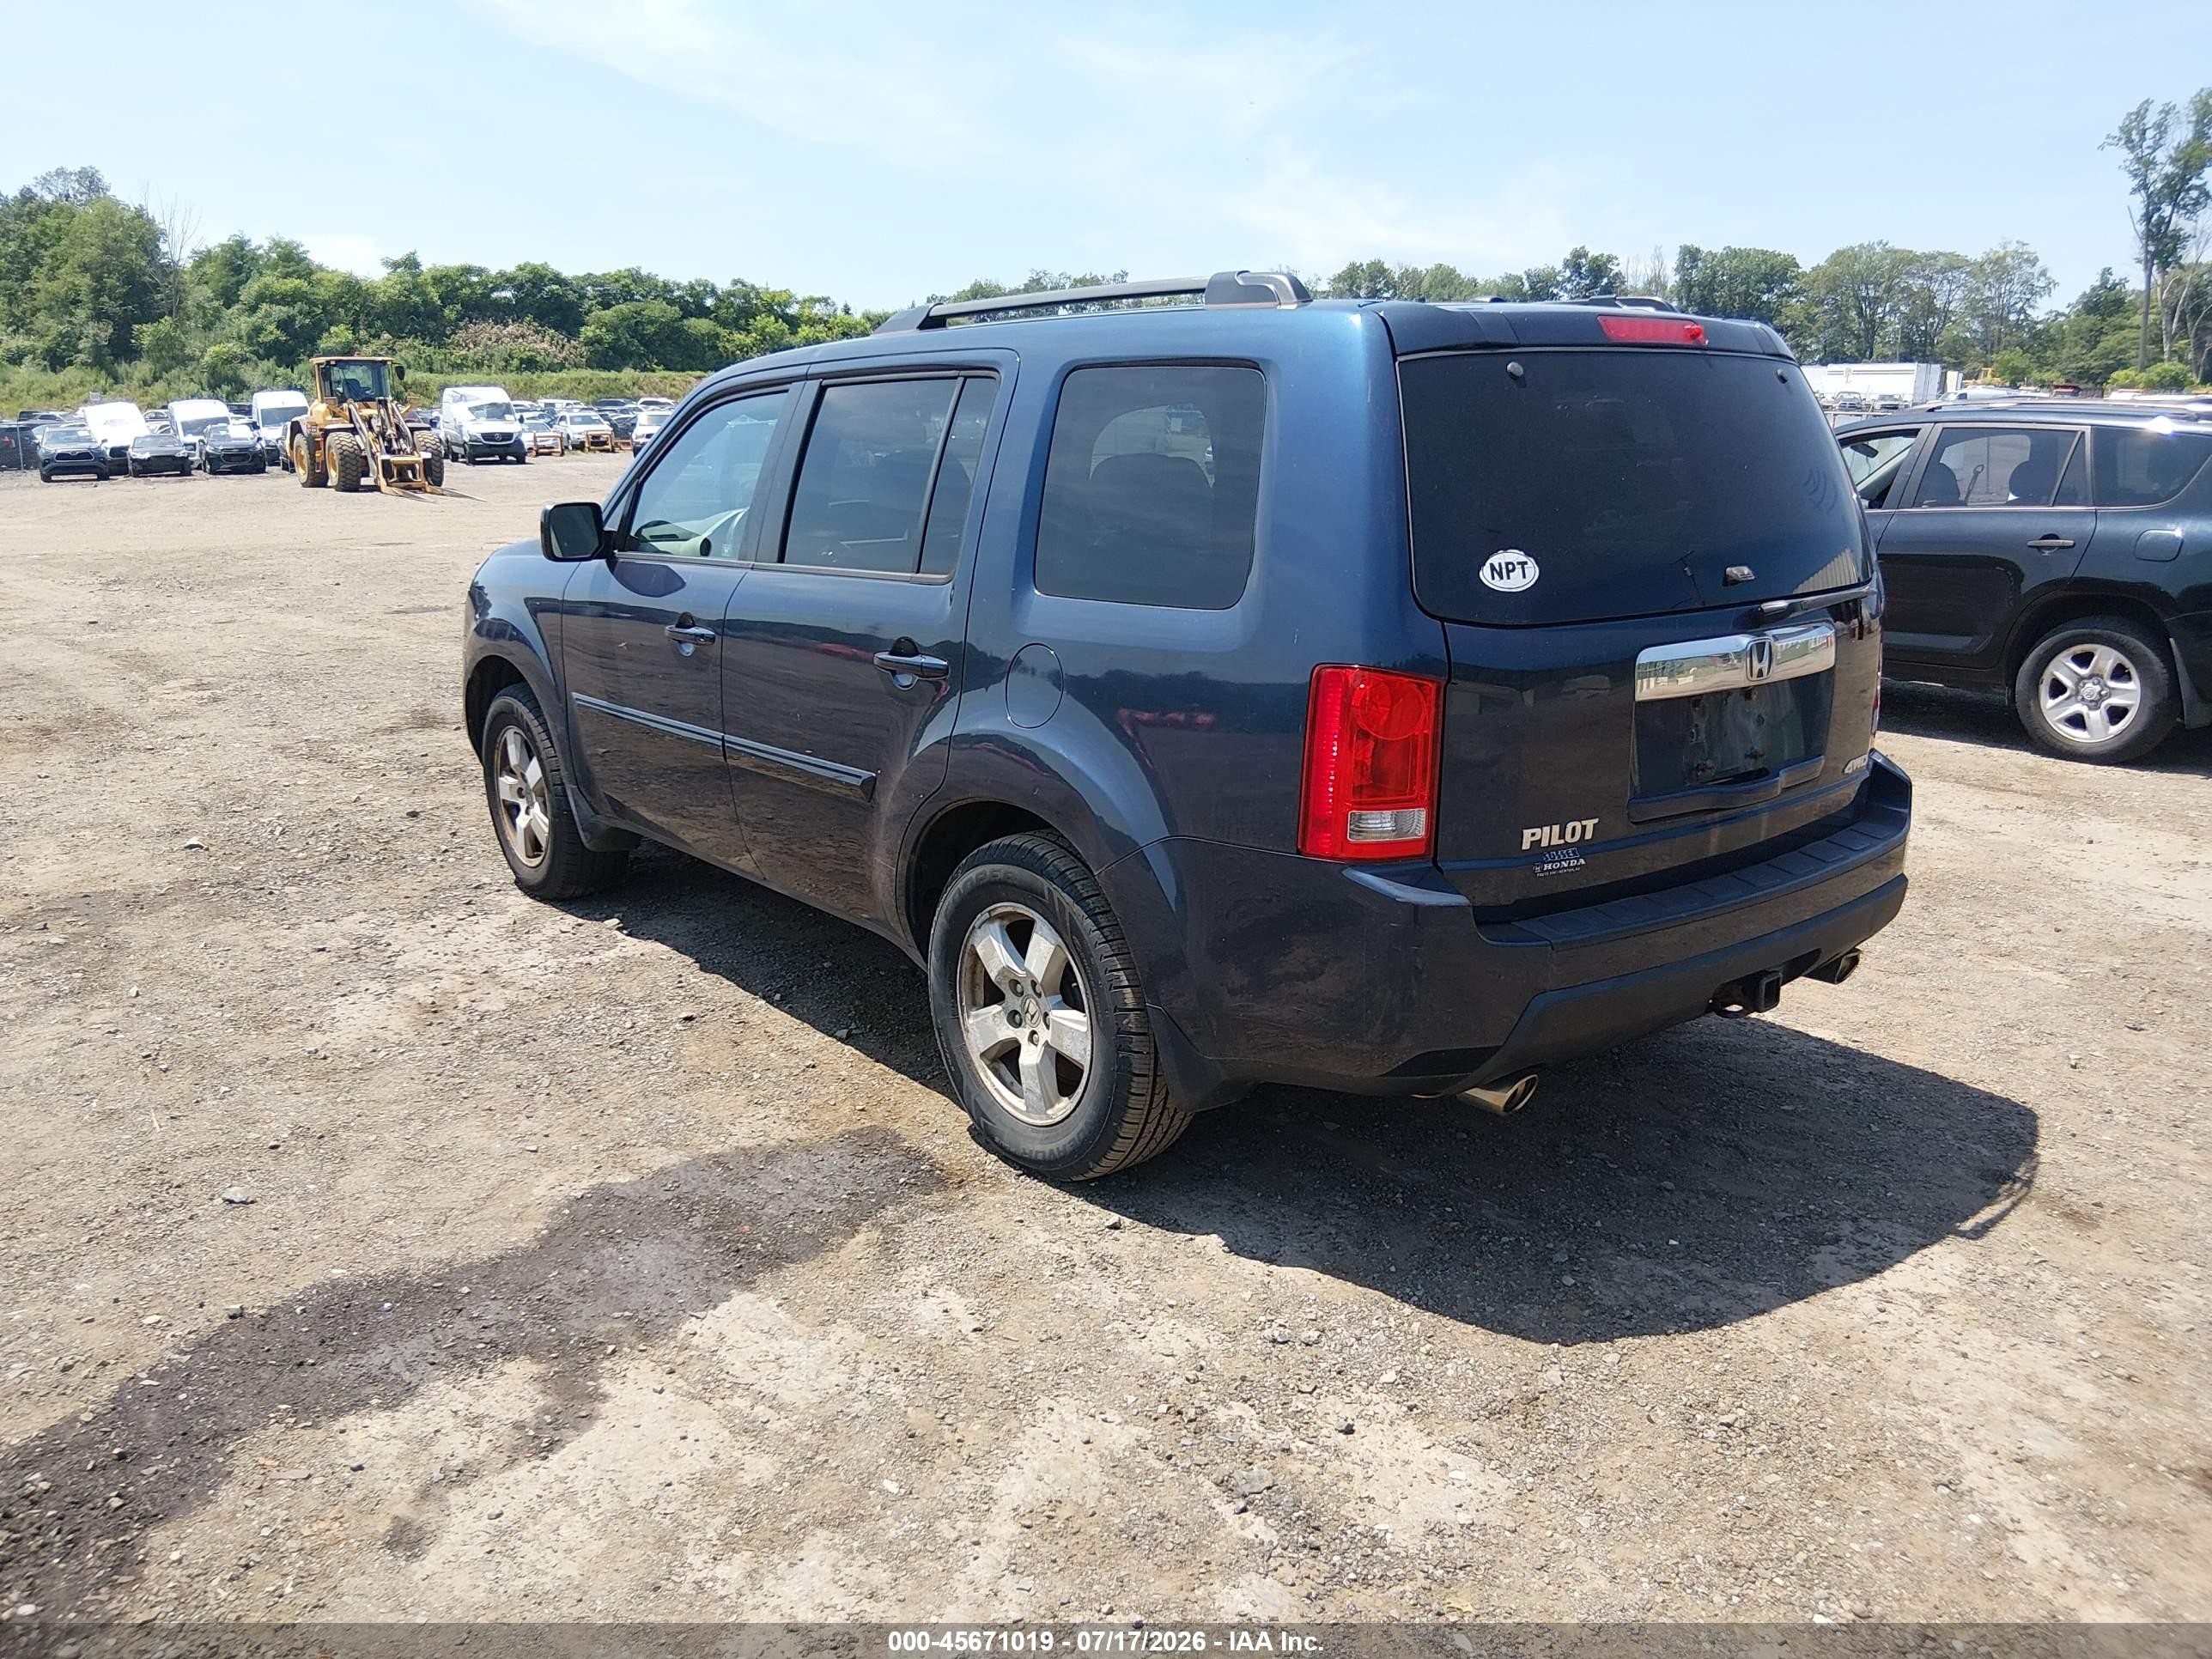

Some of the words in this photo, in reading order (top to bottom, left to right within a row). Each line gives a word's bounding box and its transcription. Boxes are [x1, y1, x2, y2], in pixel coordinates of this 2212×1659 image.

[1489, 561, 1528, 580] NPT
[1522, 818, 1599, 849] PILOT
[1543, 858, 1586, 871] HONDA
